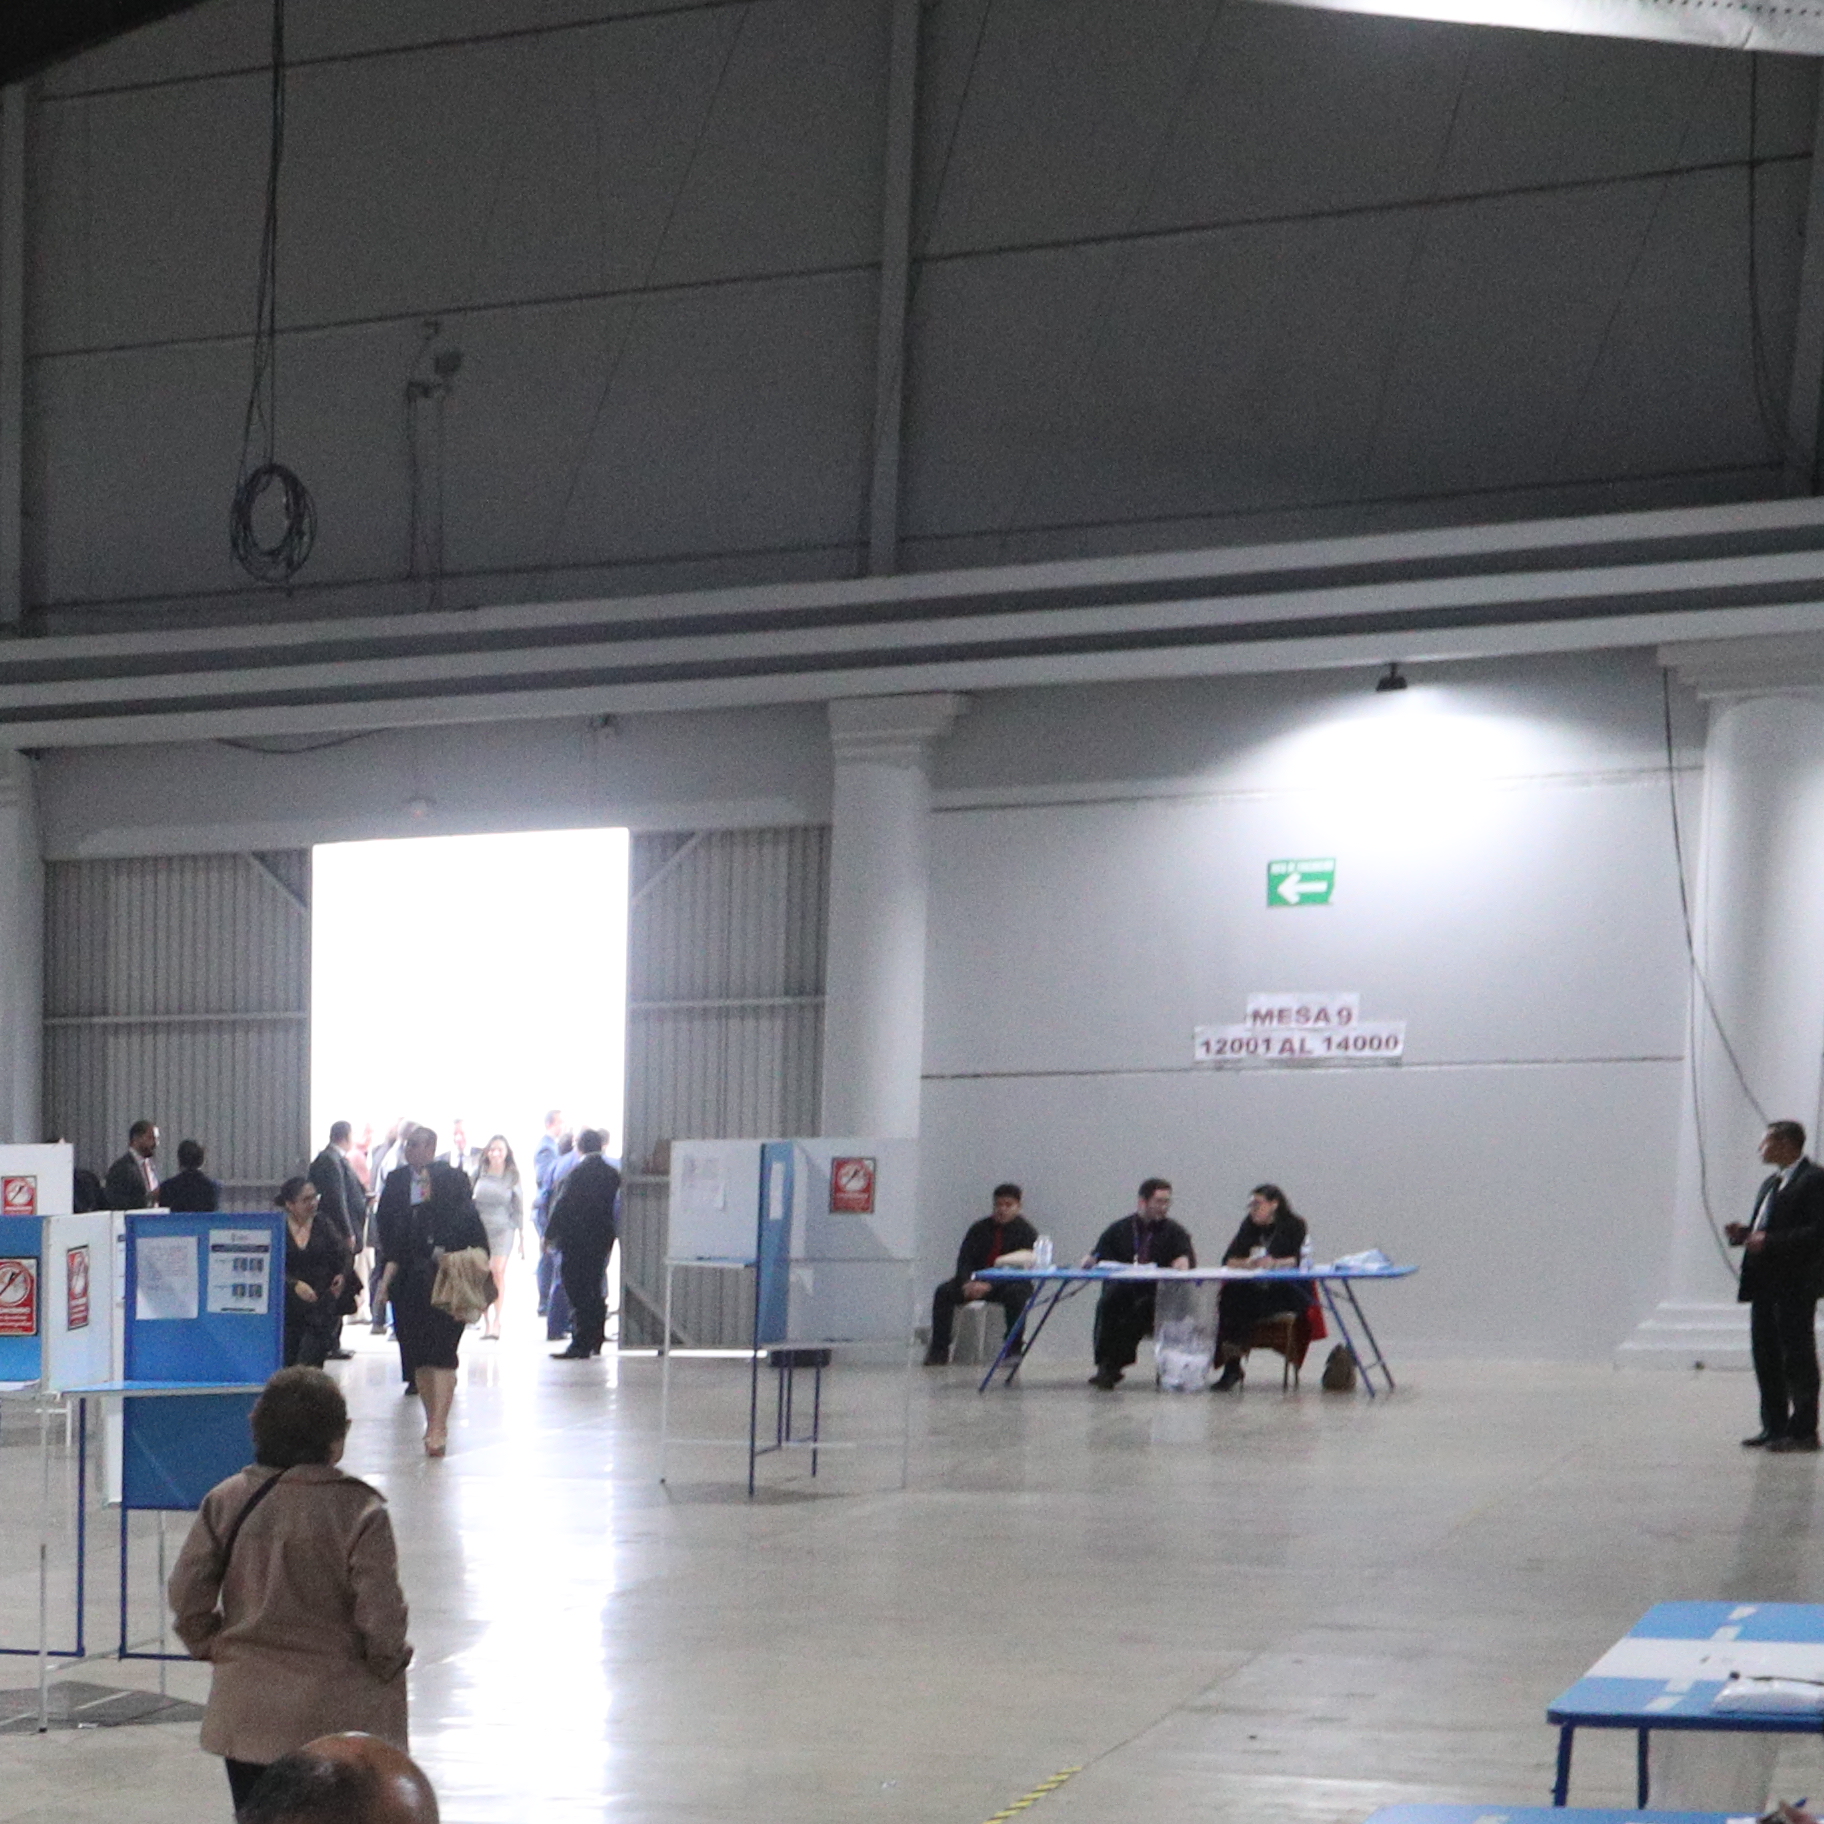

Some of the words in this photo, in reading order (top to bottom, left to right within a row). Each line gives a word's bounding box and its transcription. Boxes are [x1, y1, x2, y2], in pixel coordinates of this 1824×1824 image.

[1252, 1007, 1331, 1026] MESA
[1337, 1006, 1353, 1026] 9
[1202, 1036, 1272, 1055] 12001
[1278, 1037, 1313, 1056] AL
[1323, 1035, 1400, 1052] 14000
